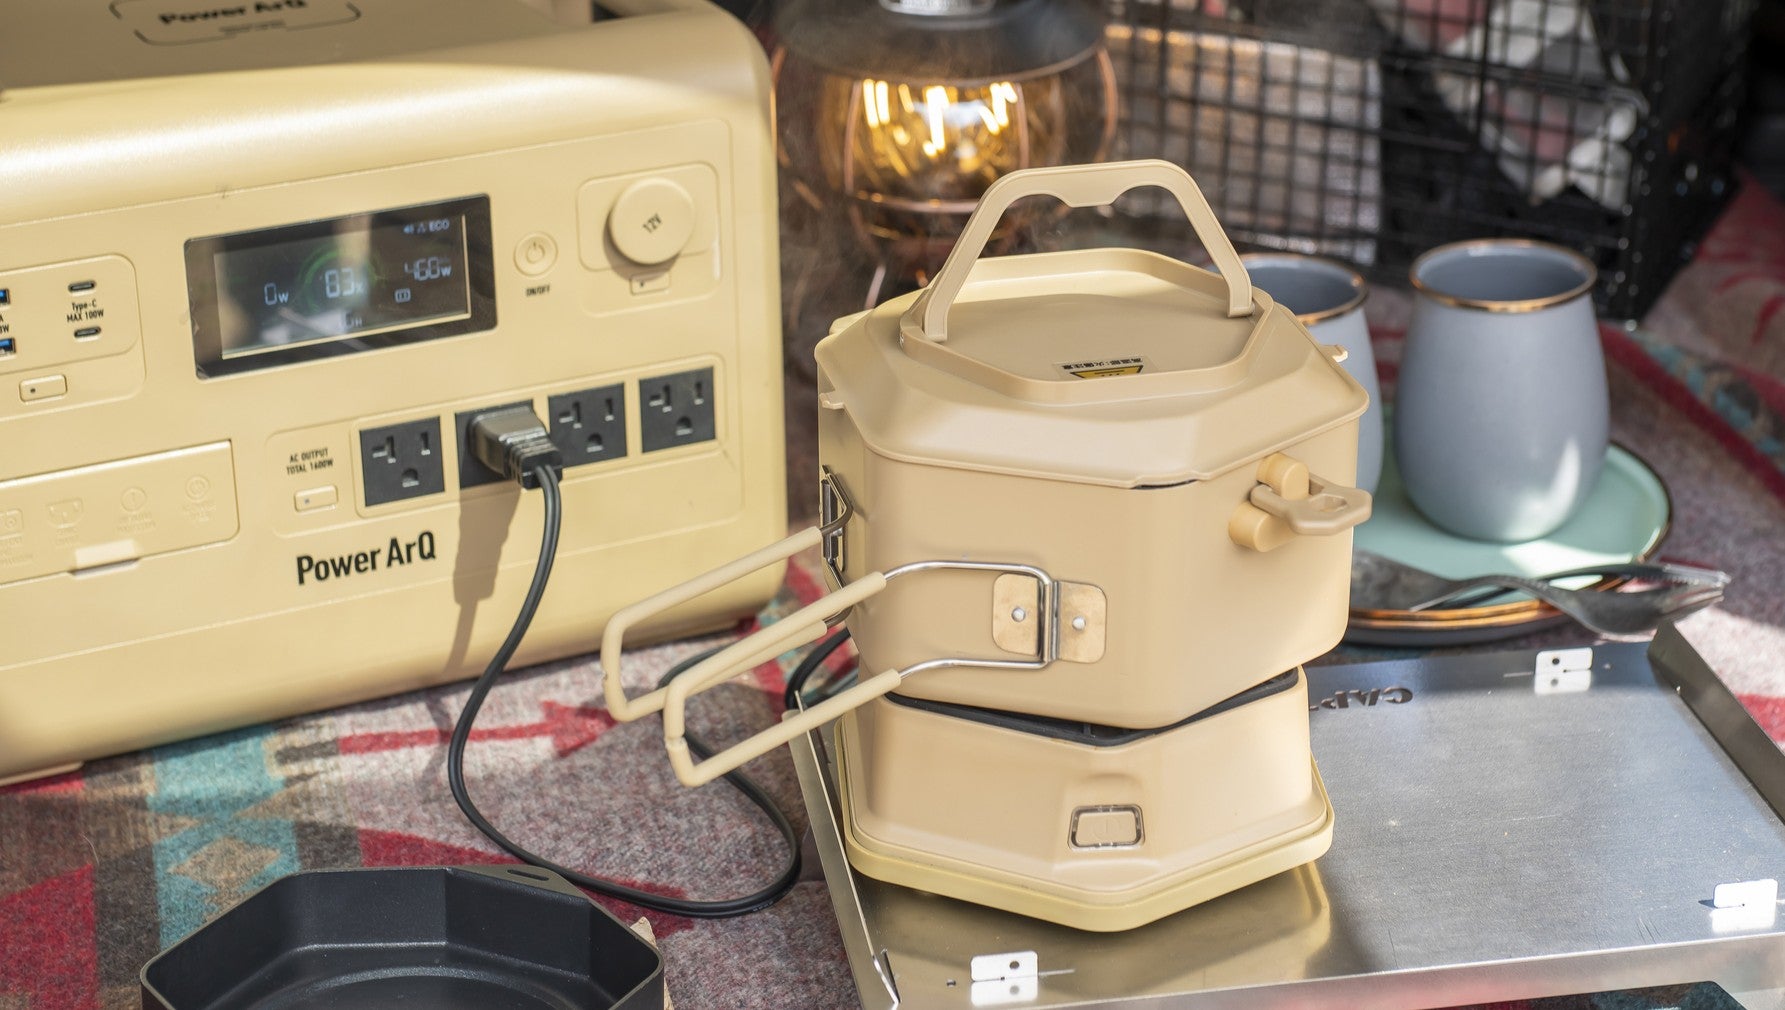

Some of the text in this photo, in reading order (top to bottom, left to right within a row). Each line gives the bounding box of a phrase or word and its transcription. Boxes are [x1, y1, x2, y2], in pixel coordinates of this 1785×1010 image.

[525, 284, 551, 297] ON/OFF
[66, 308, 105, 323] MAX 100W
[289, 447, 329, 464] AC OUTPUT
[286, 458, 334, 476] TOTAL 1600W
[296, 530, 437, 586] Power ArQ
